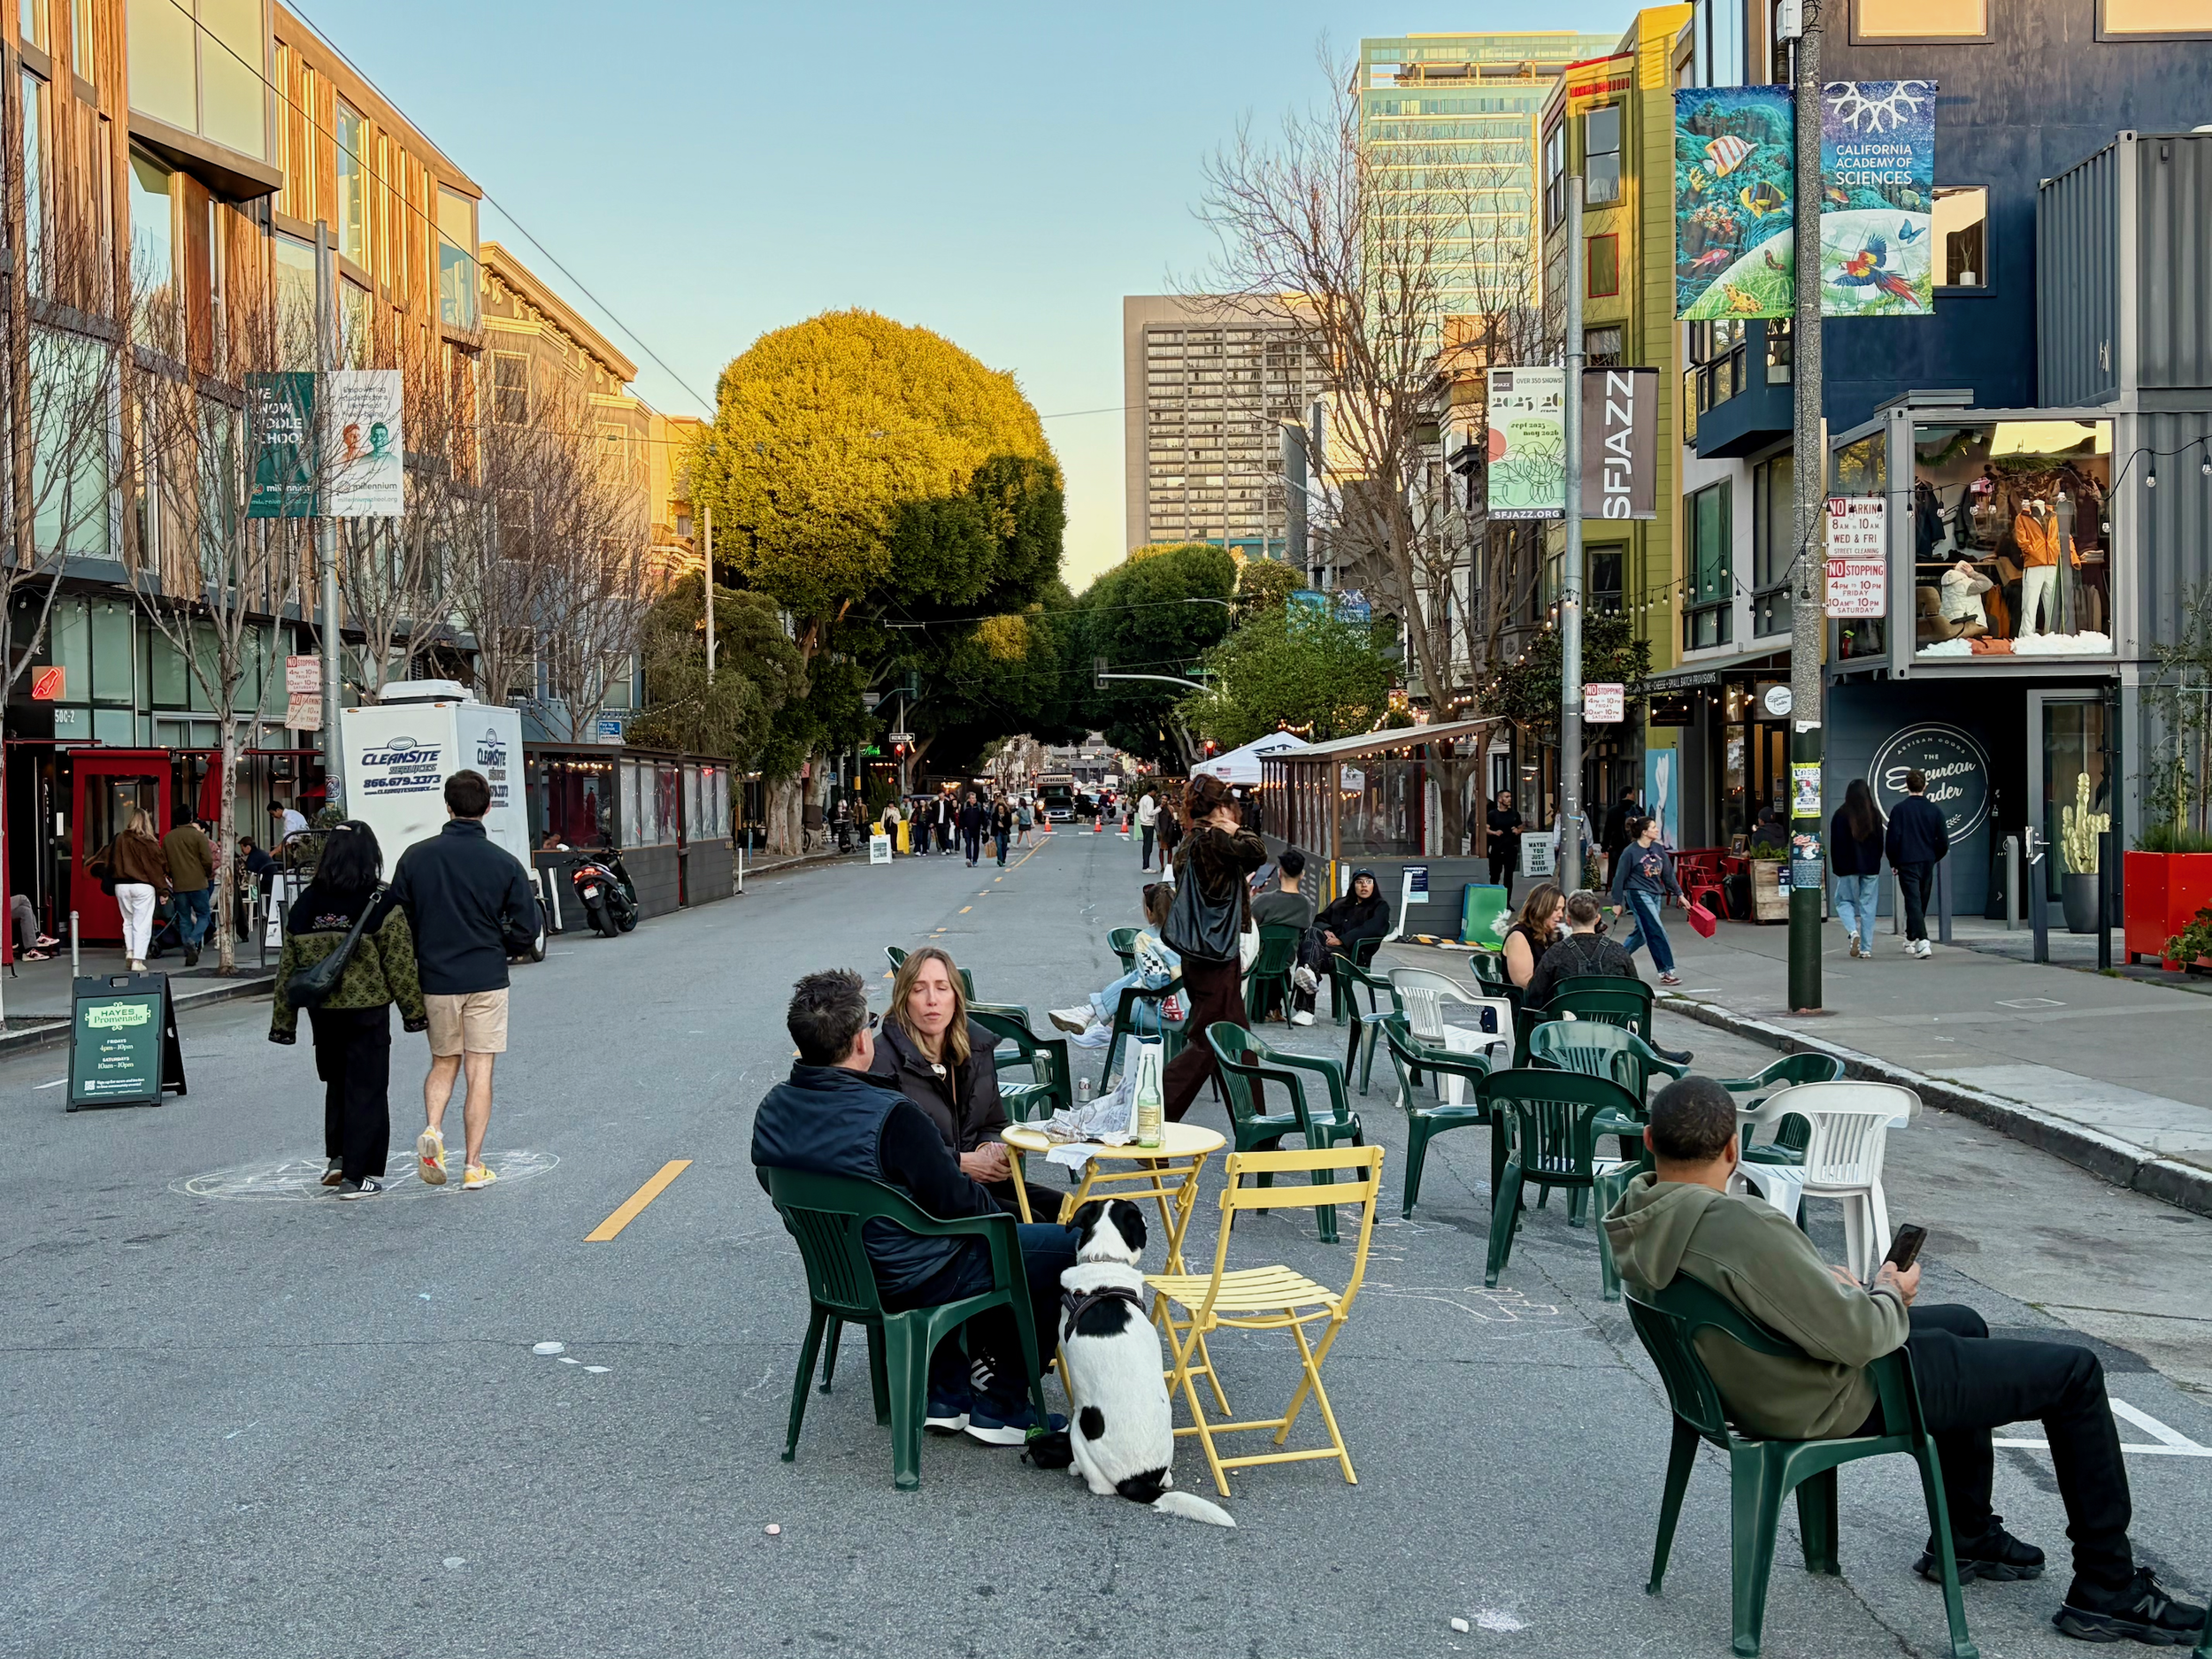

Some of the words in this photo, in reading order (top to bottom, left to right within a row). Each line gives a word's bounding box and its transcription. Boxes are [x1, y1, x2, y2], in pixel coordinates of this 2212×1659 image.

[1836, 144, 1912, 155] CALIFORNIA
[1836, 157, 1895, 168] ACADEMY
[1897, 157, 1912, 168] OF
[1836, 171, 1912, 185] SCIENCES
[250, 403, 293, 414] NOW
[1603, 370, 1634, 519] SFJAZZ
[1829, 500, 1844, 516] NO
[1494, 510, 1560, 519] SFJAZZ.ORG
[1834, 534, 1850, 543] WED
[1854, 534, 1860, 543] &
[1864, 534, 1877, 543] FRI
[1829, 562, 1844, 576] NO
[1846, 565, 1883, 576] STOPPING
[288, 657, 296, 667] NO
[1668, 678, 1680, 688] SMALL
[1681, 676, 1692, 687] BATCH
[1693, 672, 1716, 684] PROVISIONS
[1587, 685, 1596, 695] NO
[290, 695, 301, 705] NO
[1897, 737, 1933, 755] ARTISAN
[1938, 738, 1966, 754] GOODS
[362, 750, 441, 766] CLEANSITE
[363, 775, 441, 788] 866.679.3373
[101, 1008, 135, 1017] HAYES
[94, 1014, 143, 1023] Promenade
